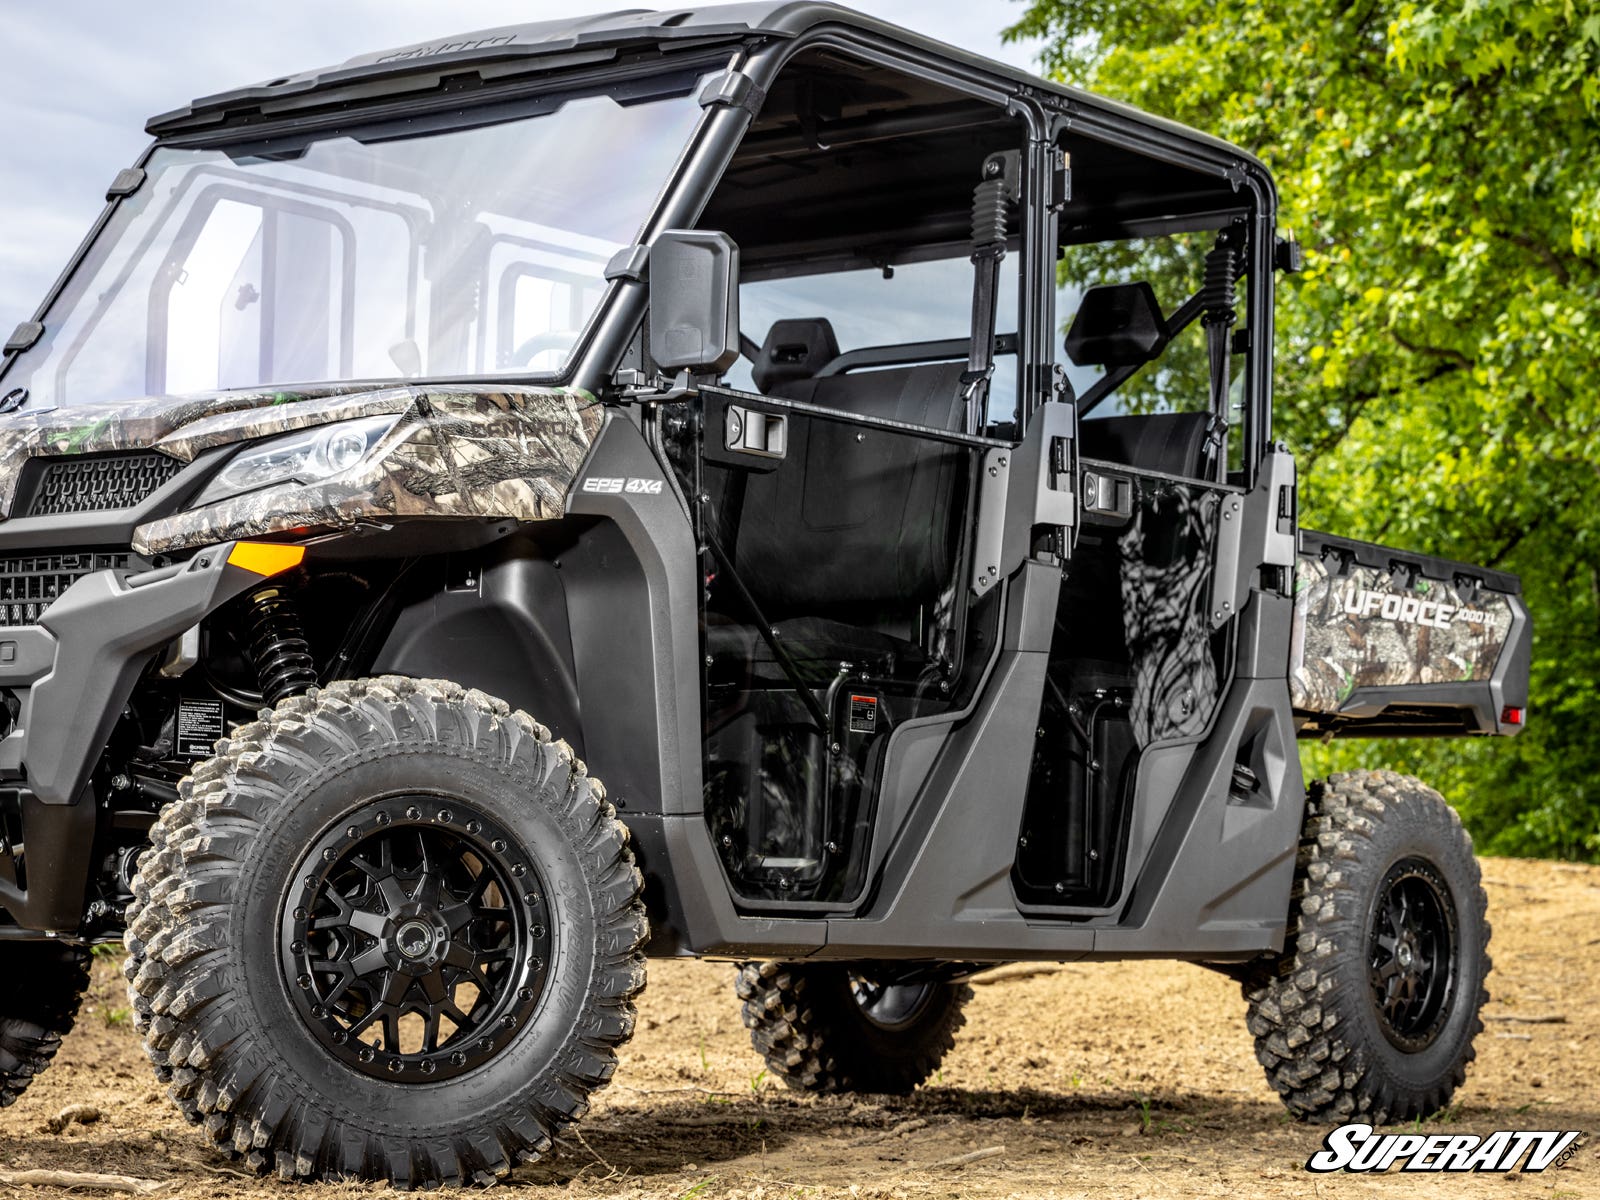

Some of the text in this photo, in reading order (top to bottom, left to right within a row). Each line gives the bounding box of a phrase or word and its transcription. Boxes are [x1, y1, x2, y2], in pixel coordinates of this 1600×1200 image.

[582, 477, 663, 494] EPS 4X4
[1344, 588, 1456, 630] UFORCE
